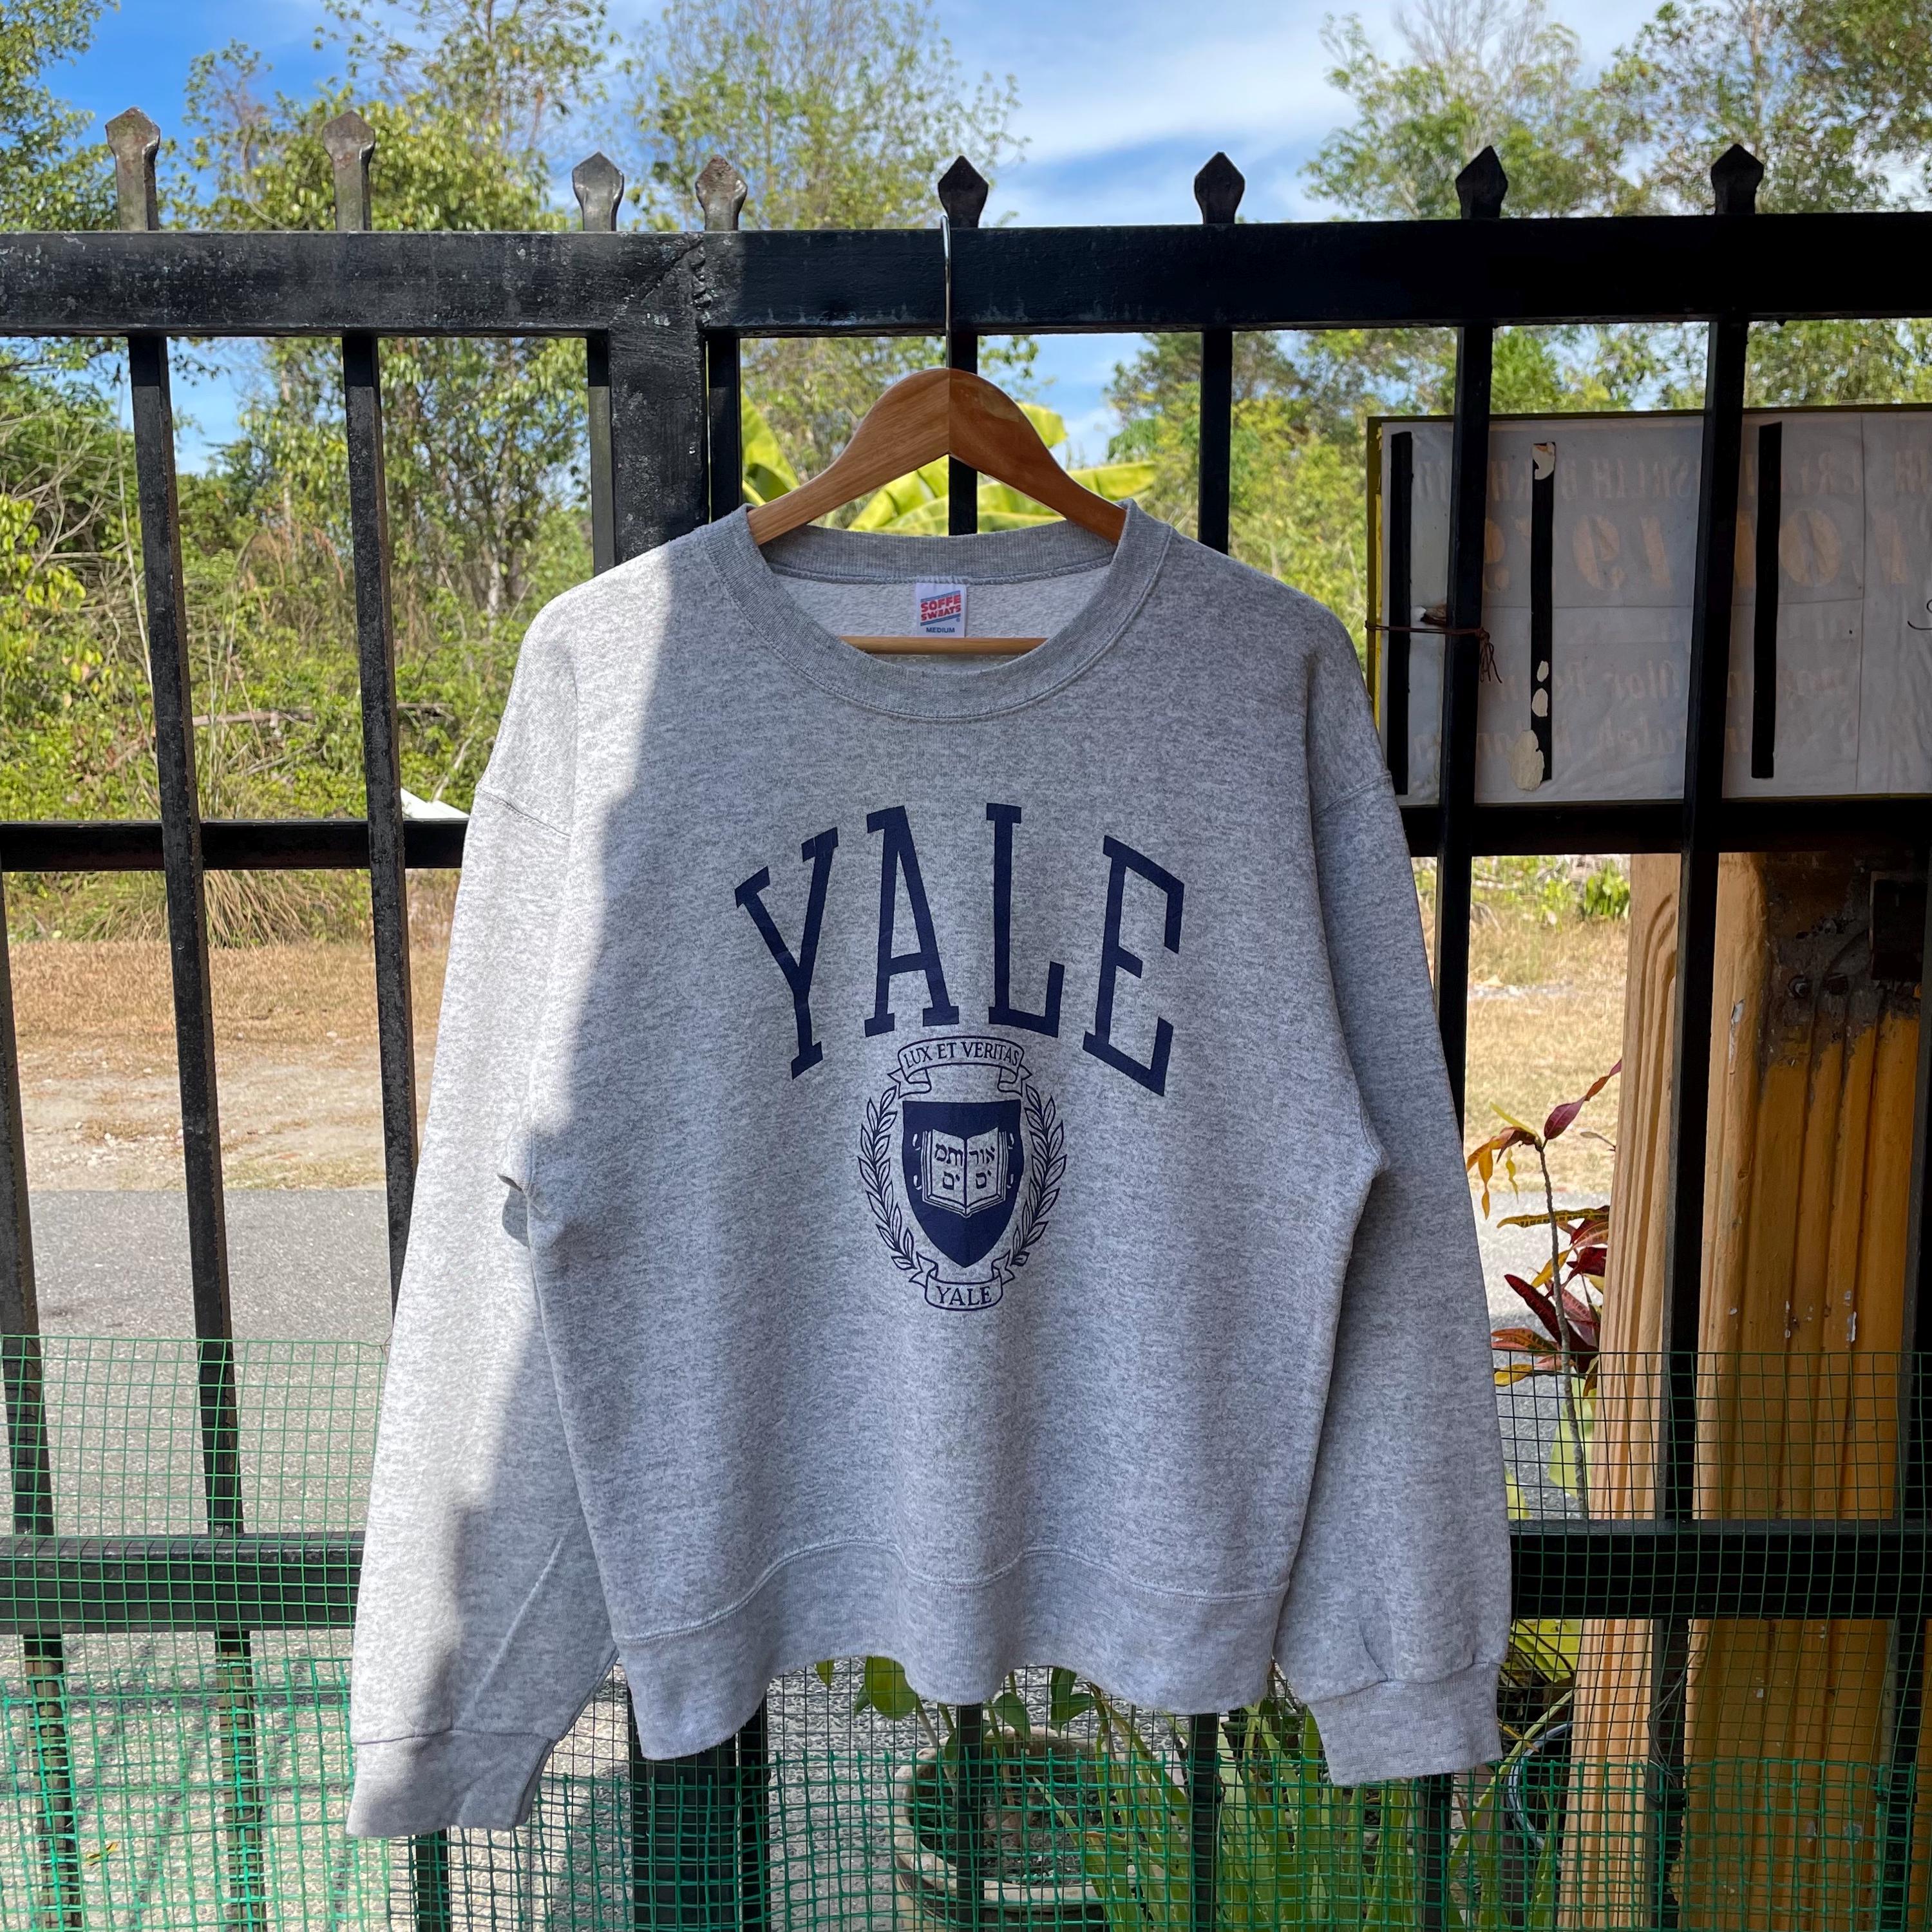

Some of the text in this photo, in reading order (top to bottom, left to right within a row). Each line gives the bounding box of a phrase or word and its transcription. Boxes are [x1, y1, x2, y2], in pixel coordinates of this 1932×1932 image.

[921, 595, 961, 612] SOFFE
[921, 605, 961, 620] SWEATS
[734, 802, 1184, 1097] YALE
[904, 1042, 1019, 1068] LUX ET VERITAS
[936, 1286, 992, 1306] YALE
